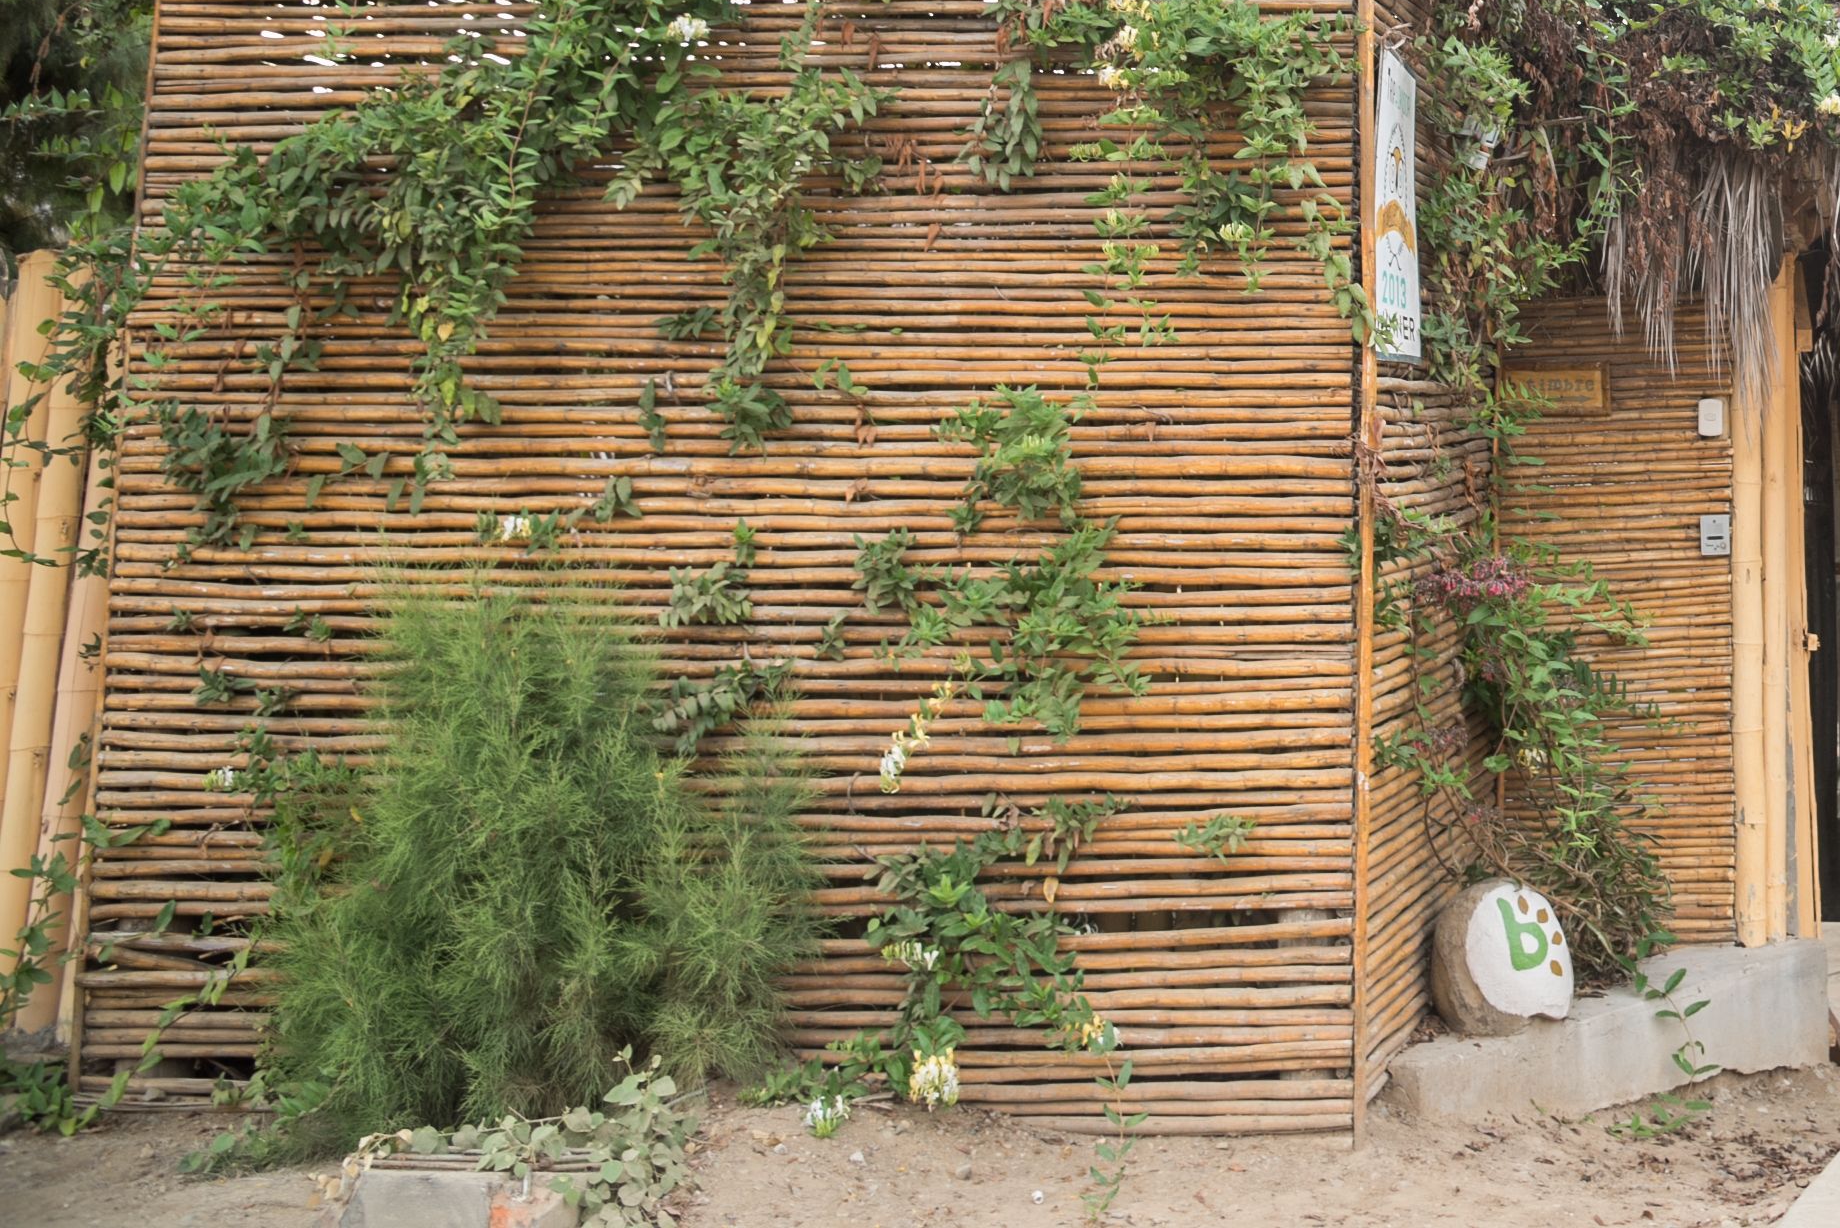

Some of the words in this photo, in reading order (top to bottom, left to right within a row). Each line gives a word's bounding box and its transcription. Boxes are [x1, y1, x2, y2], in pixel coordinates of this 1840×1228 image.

[1382, 270, 1407, 309] 2013
[1527, 378, 1595, 392] timbre
[1496, 897, 1549, 972] b
